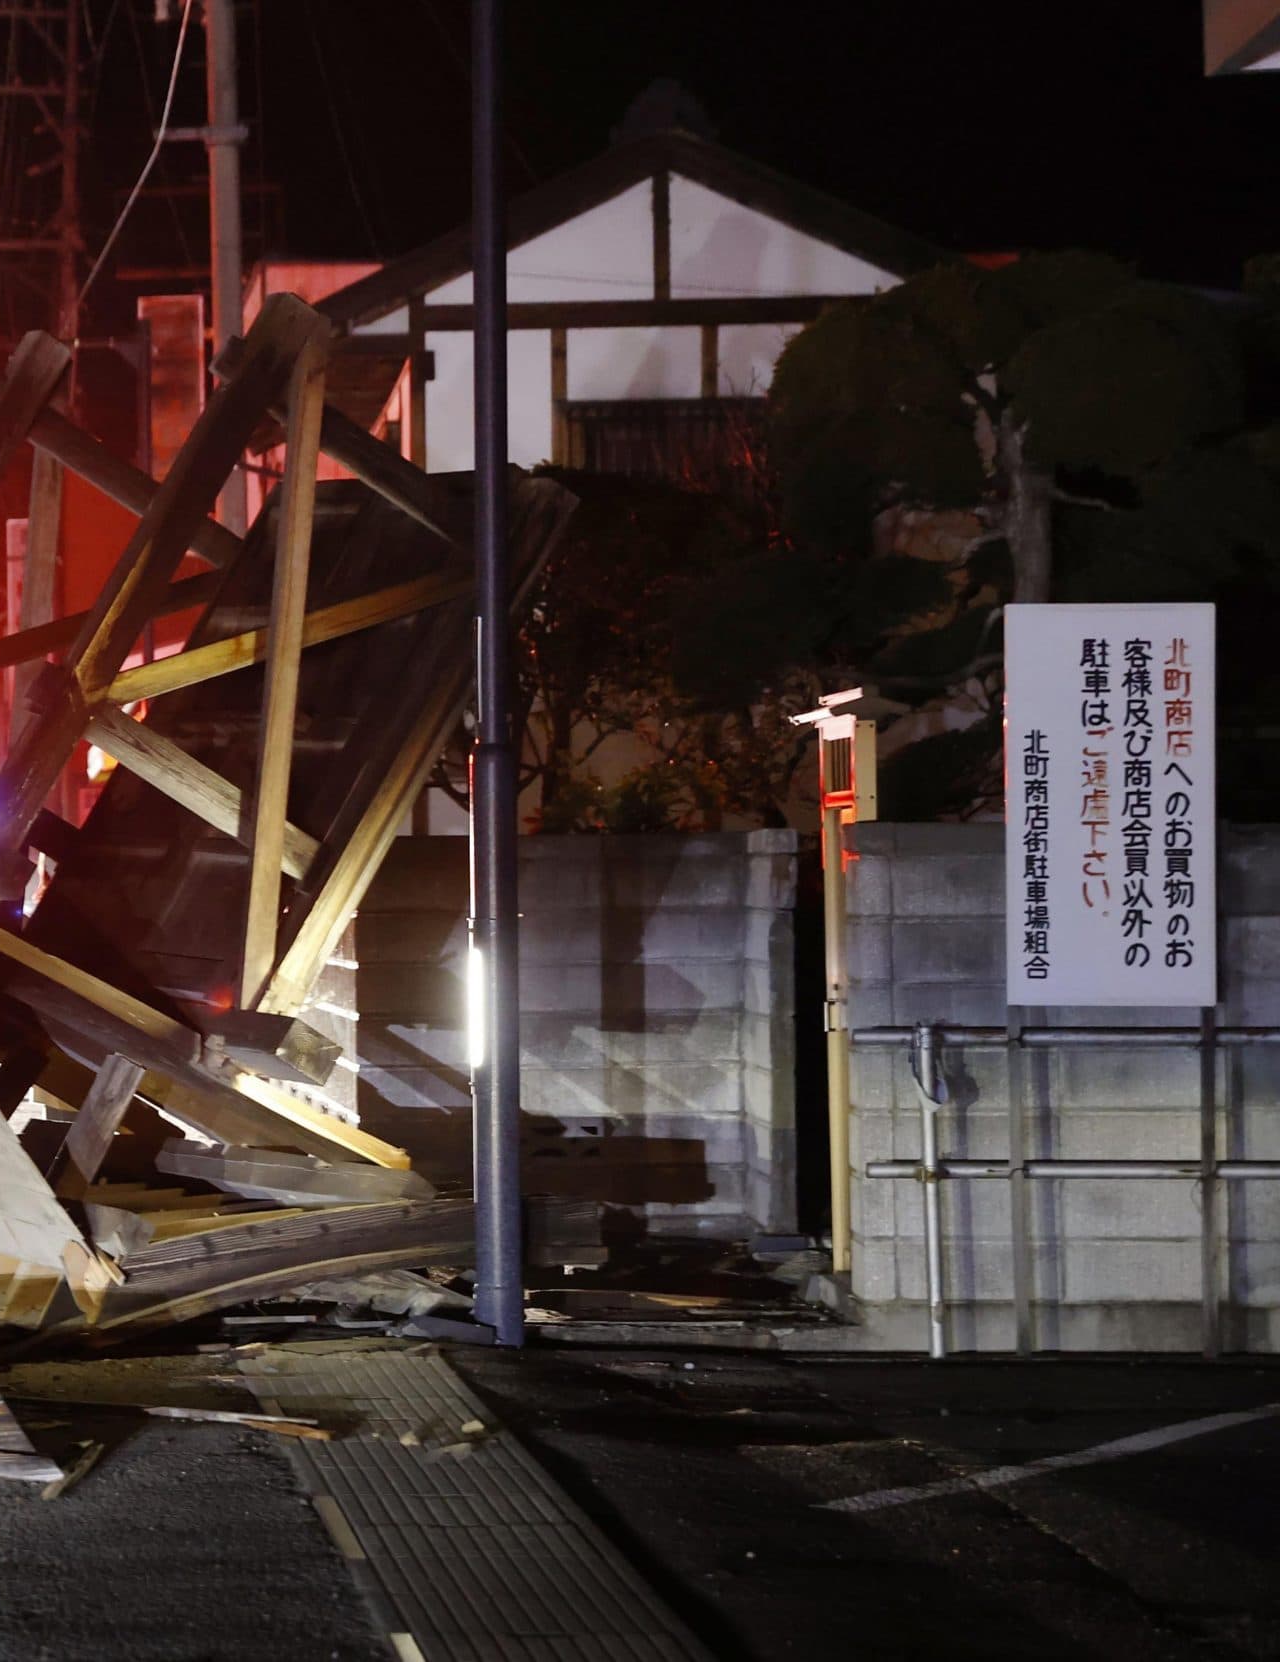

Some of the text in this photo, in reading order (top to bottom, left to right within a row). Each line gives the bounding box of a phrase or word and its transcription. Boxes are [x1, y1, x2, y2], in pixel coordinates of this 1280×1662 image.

[1023, 729, 1051, 980] 北町商店街駐車場組合
[1121, 638, 1153, 968] 客様及び商店会員以外の
[1163, 638, 1195, 968] 北町商店へのお買物のお
